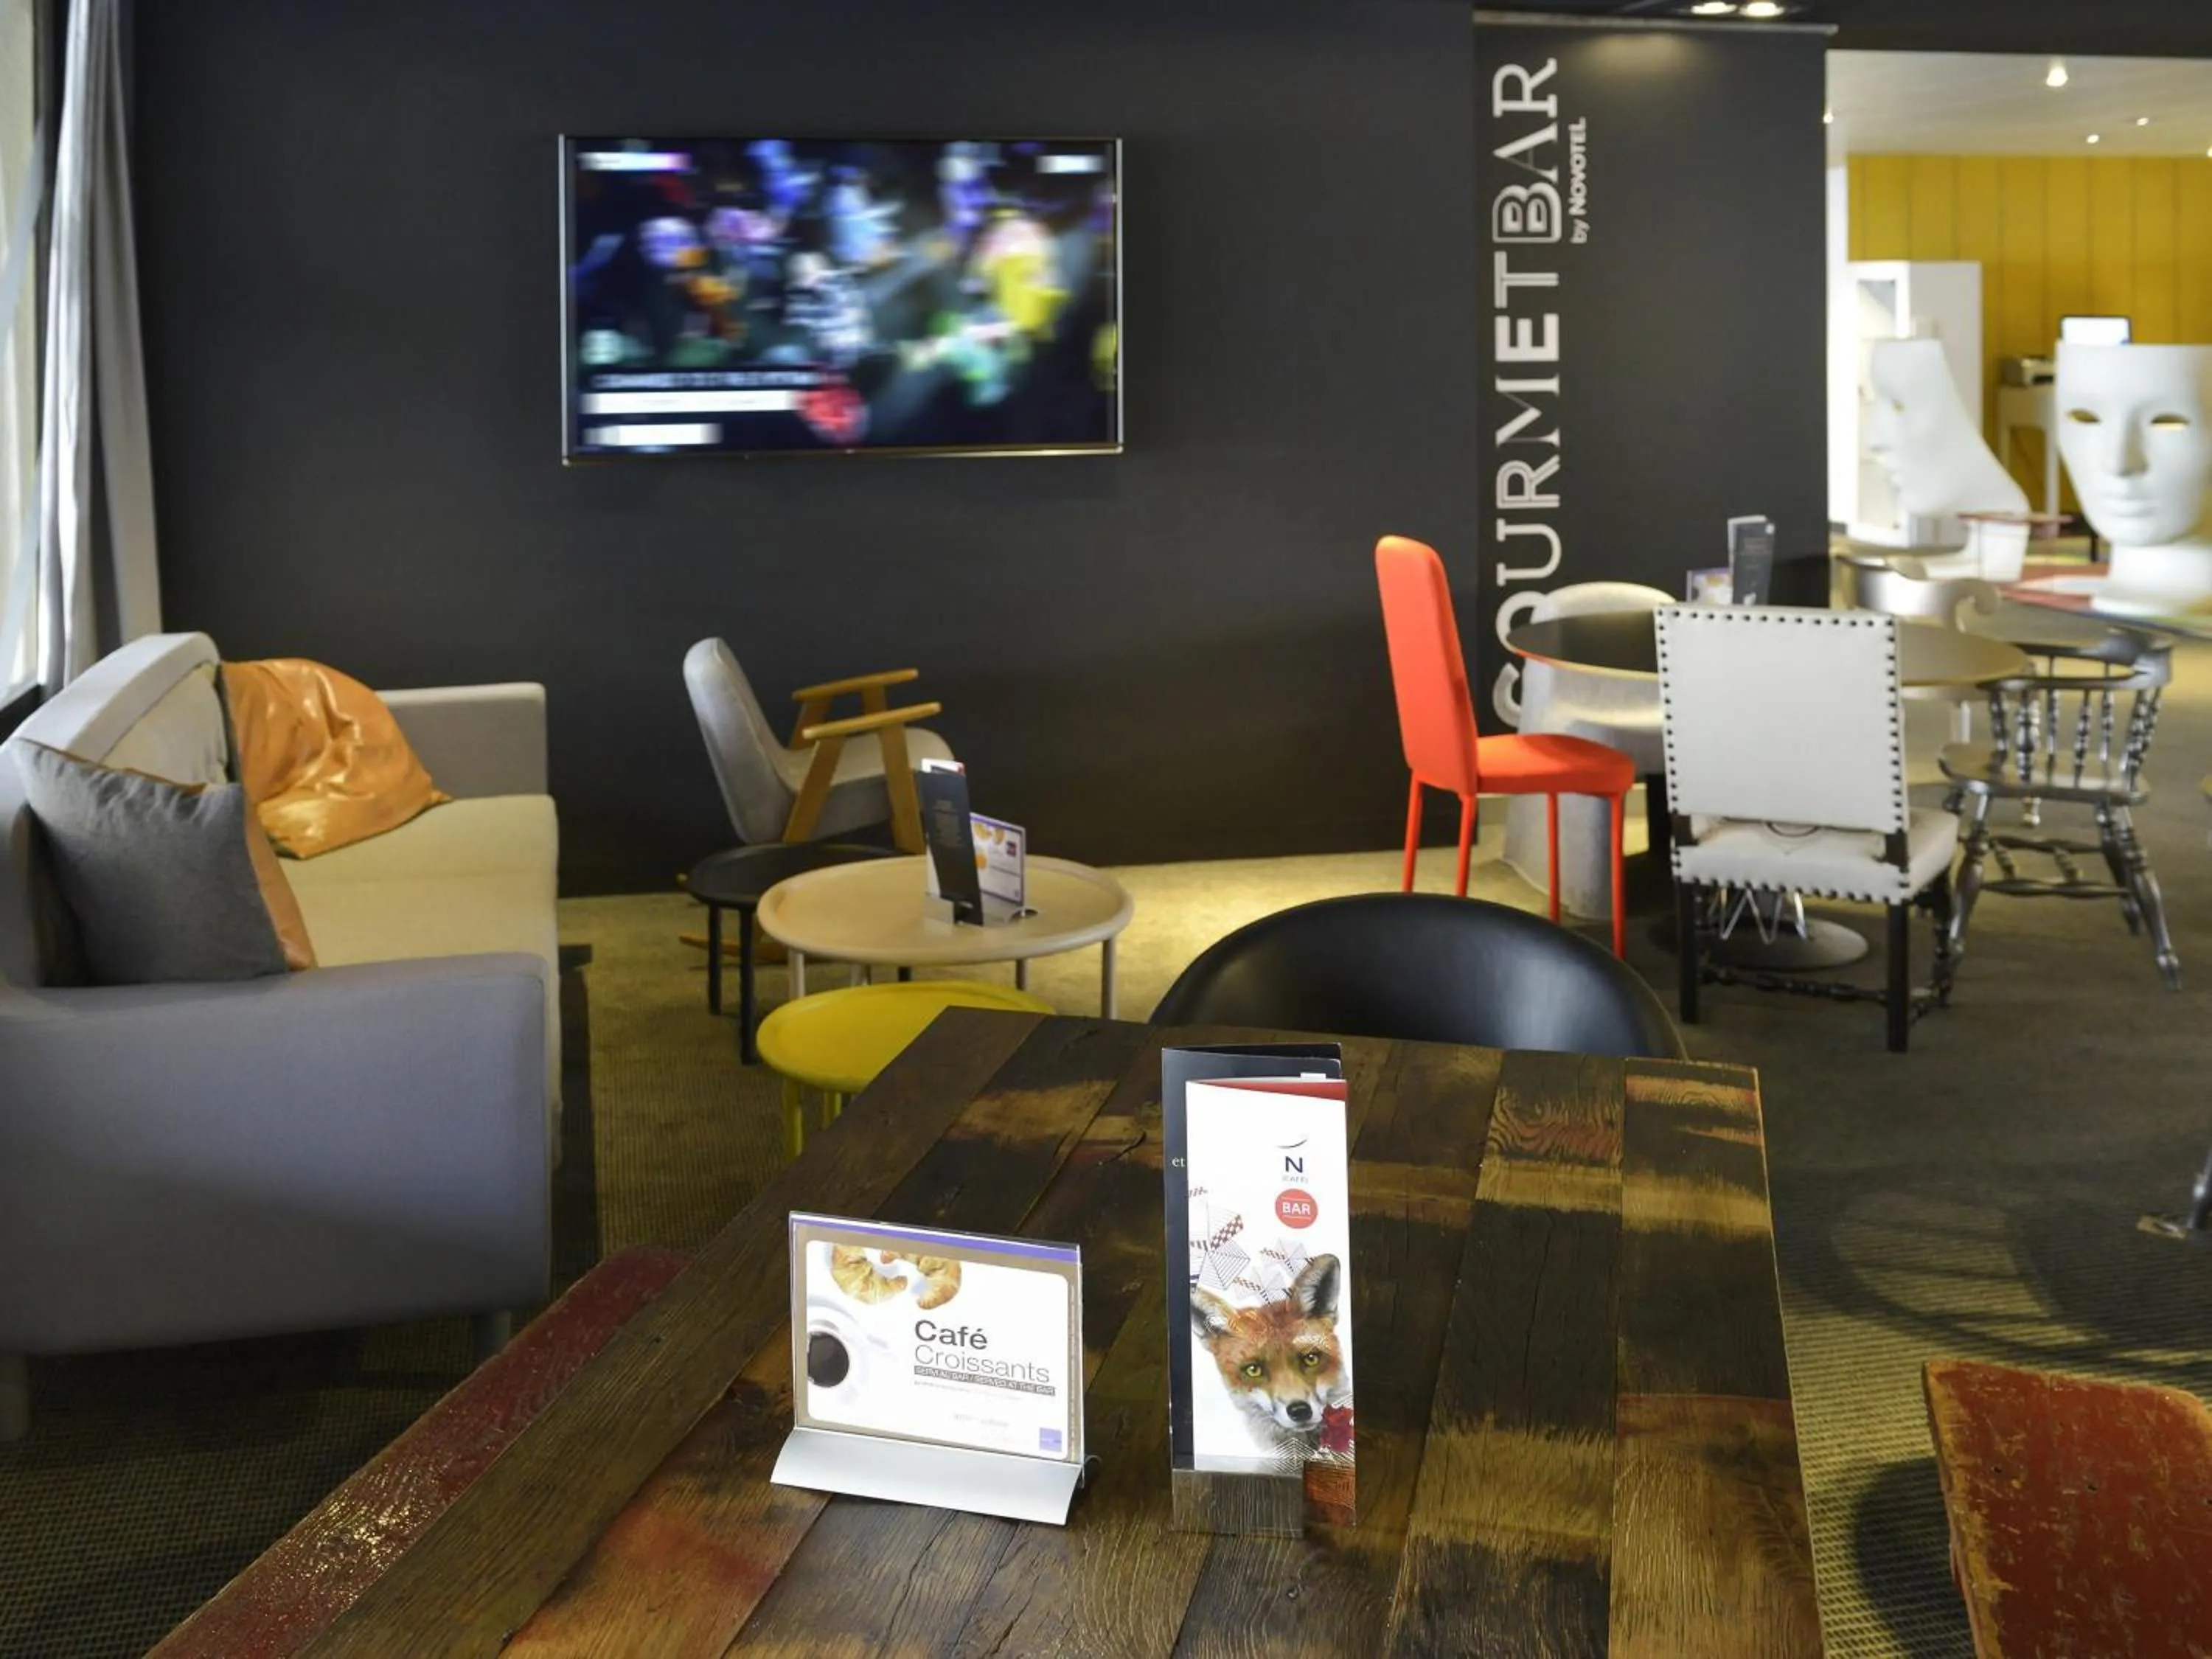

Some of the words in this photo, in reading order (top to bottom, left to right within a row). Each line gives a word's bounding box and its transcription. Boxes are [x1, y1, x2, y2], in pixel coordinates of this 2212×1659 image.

[1568, 116, 1587, 215] NOVOTEL
[1570, 218, 1590, 244] by
[1285, 1155, 1303, 1173] N
[1282, 1201, 1310, 1215] BAR
[914, 1319, 988, 1350] Café
[914, 1344, 1049, 1383] Croissants
